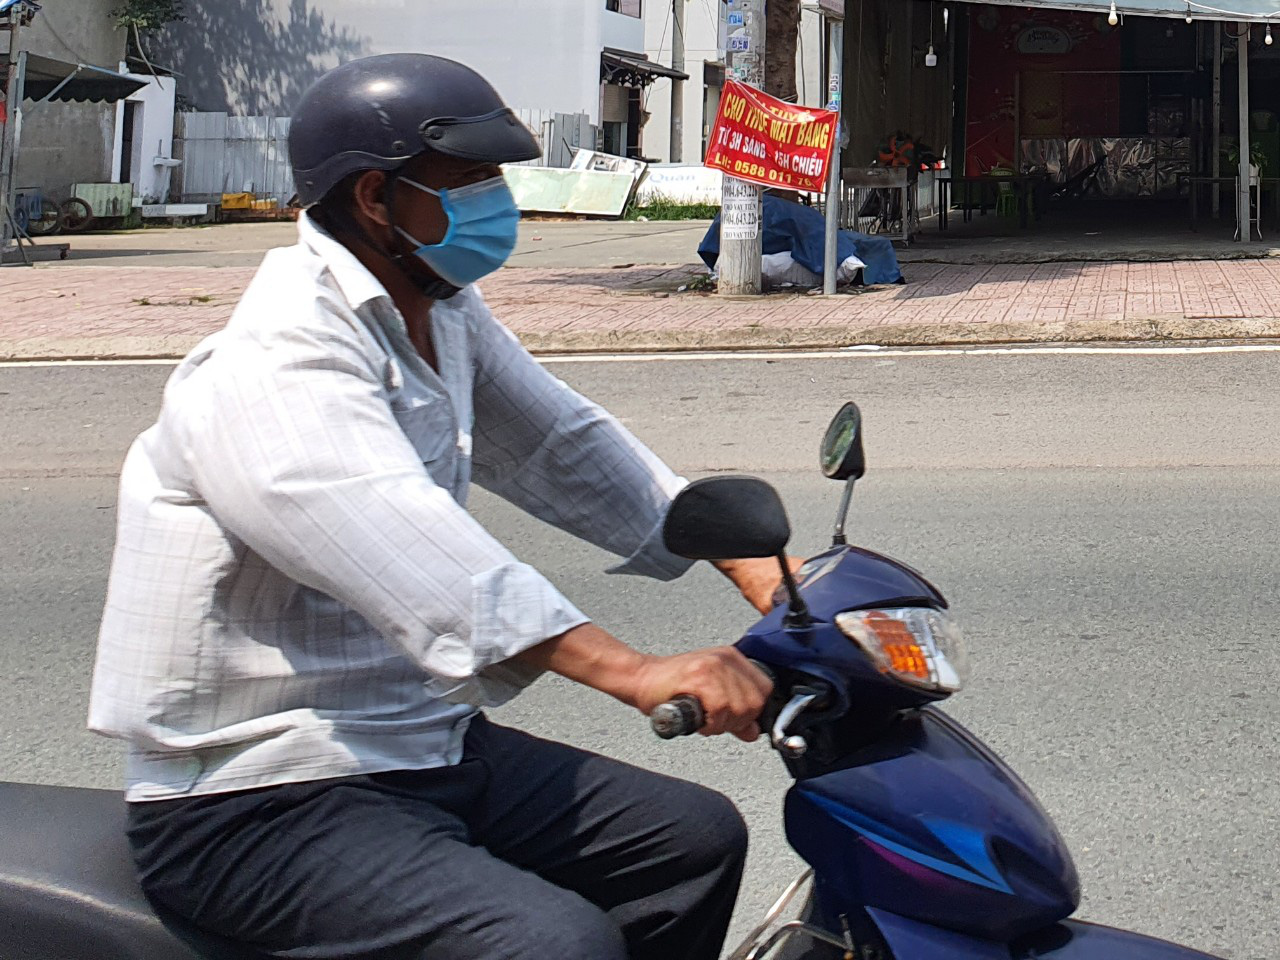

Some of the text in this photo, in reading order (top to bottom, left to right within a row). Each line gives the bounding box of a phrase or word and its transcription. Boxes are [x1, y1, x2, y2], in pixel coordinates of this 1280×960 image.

[723, 92, 746, 122] CHO
[729, 130, 742, 151] 3H
[742, 134, 766, 159] SÁNG
[714, 152, 732, 169] LH:
[734, 160, 765, 177] 0588
[768, 169, 792, 183] 011
